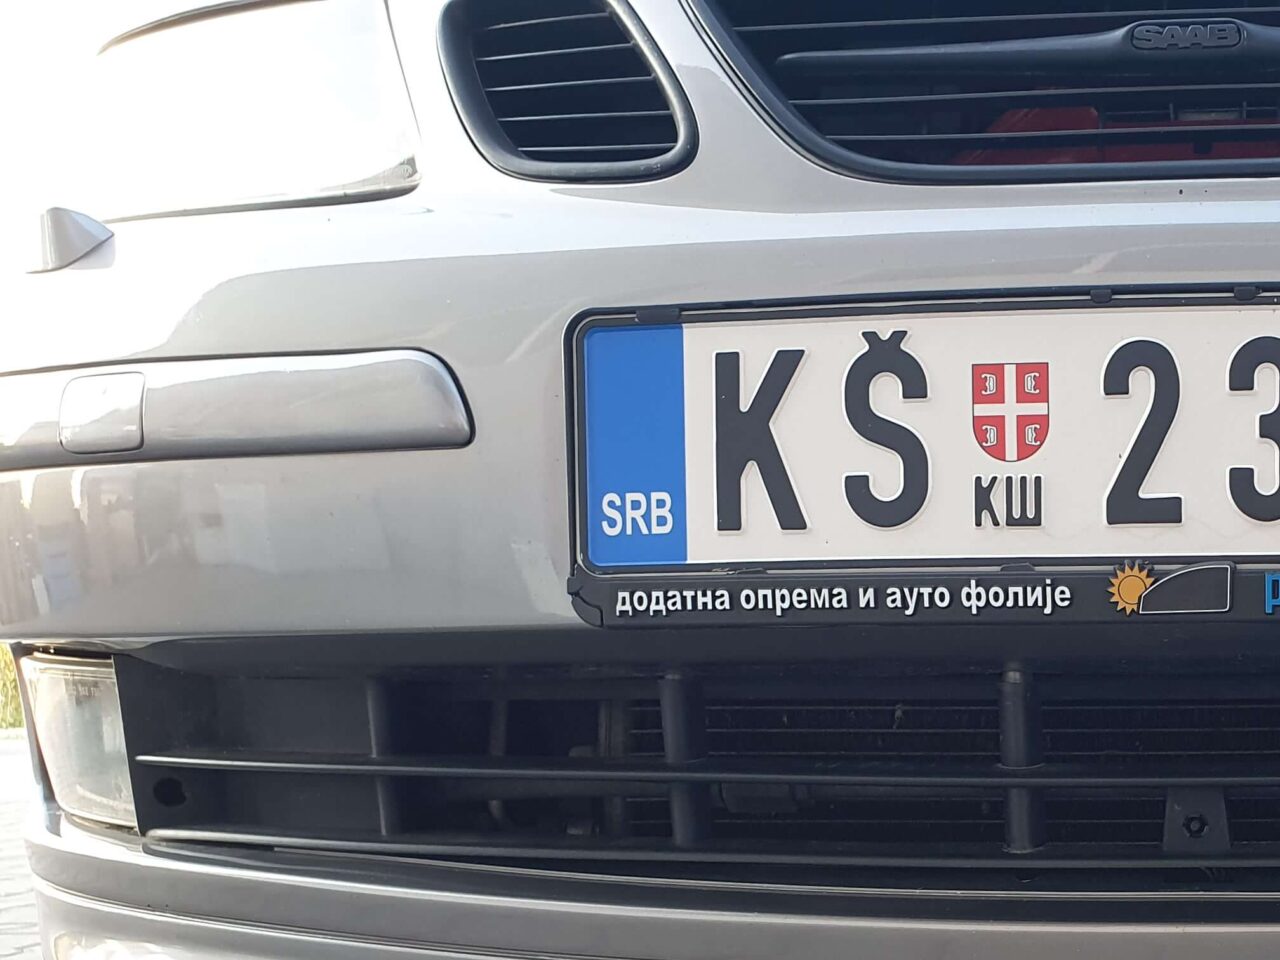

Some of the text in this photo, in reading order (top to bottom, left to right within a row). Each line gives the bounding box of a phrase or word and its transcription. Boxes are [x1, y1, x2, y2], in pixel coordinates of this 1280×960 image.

[1132, 24, 1241, 50] SAAB
[714, 330, 931, 529] KŠ
[602, 491, 673, 536] SRB
[973, 475, 1043, 527] КШ
[615, 578, 1071, 617] додатна опрема и ауто фолије
